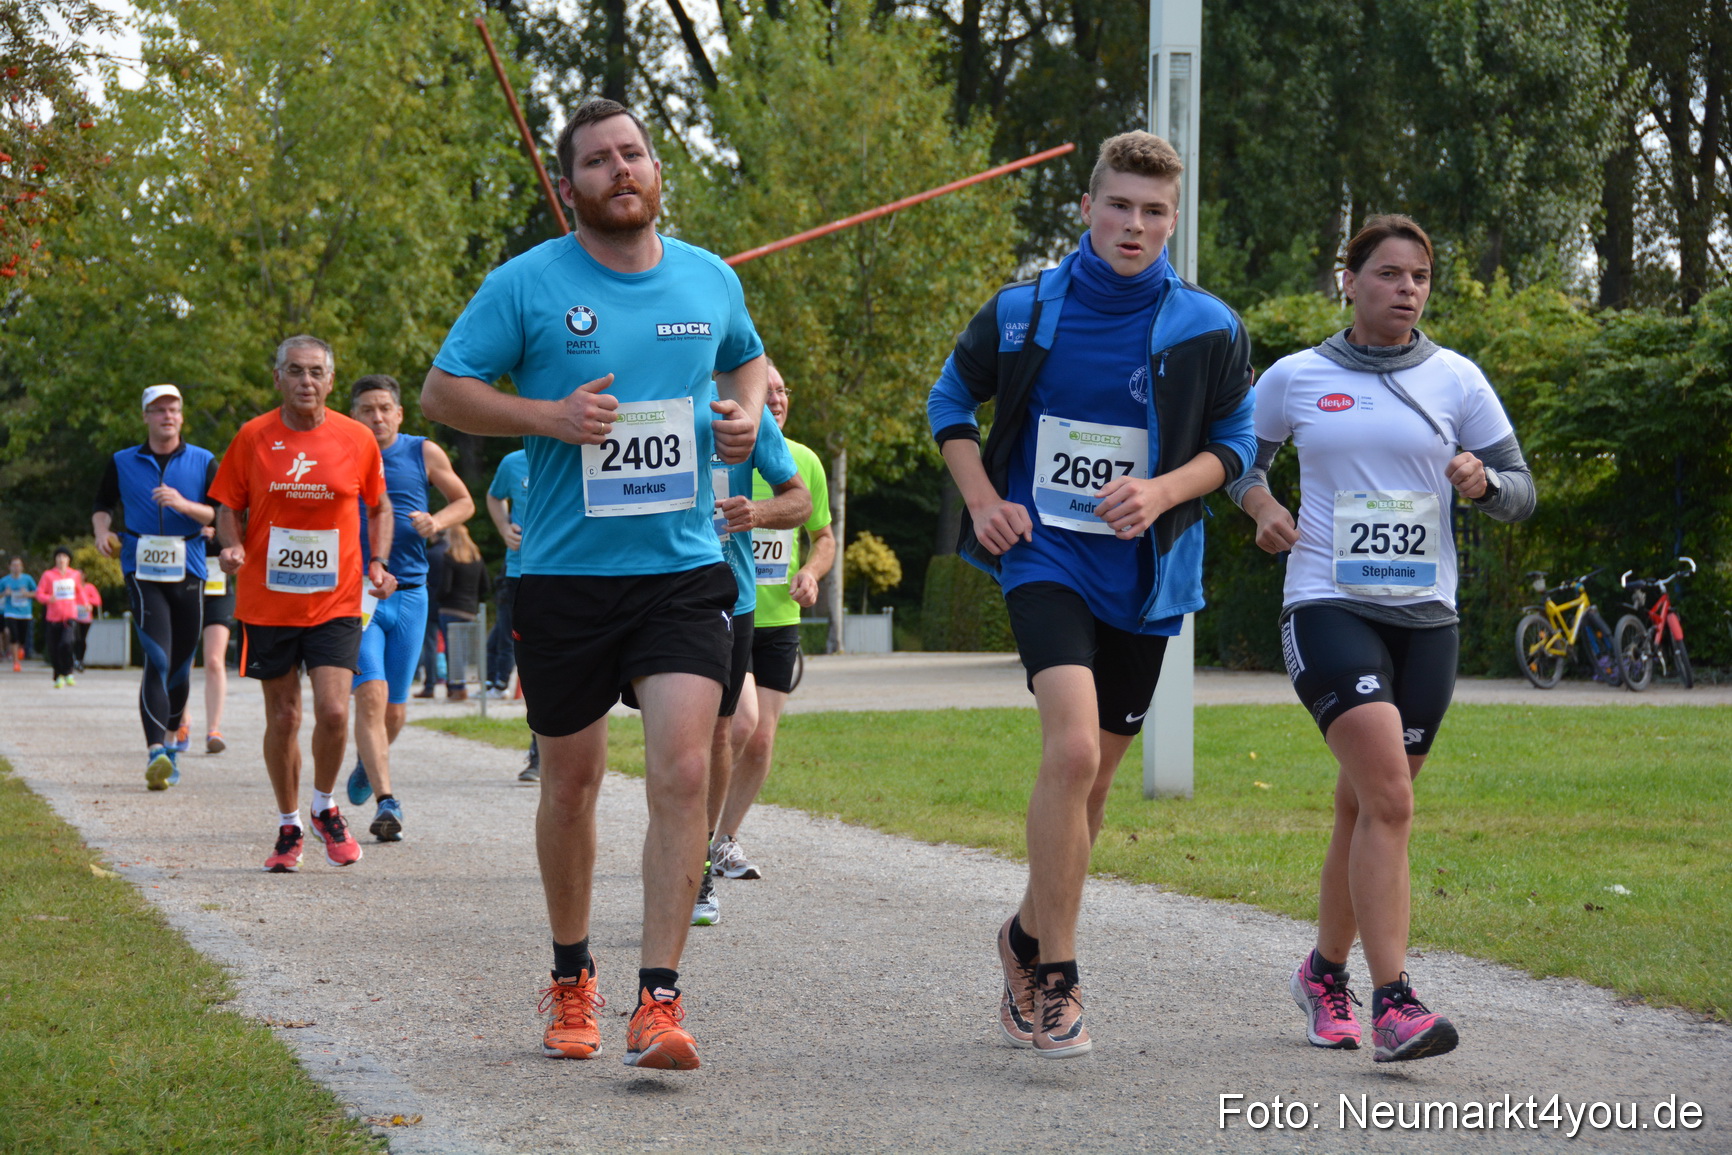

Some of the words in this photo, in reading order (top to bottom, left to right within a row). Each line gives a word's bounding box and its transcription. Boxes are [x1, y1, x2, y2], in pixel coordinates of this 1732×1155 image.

[569, 306, 595, 317] BMW
[656, 323, 711, 336] BOCK
[1005, 322, 1030, 330] GANS
[567, 341, 600, 349] PARTL
[1320, 397, 1352, 408] Hervis
[627, 411, 666, 423] BOCK
[1080, 432, 1122, 445] BOCK
[600, 434, 681, 472] 2403
[1051, 452, 1135, 490] 2697
[269, 481, 327, 493] funrunners
[623, 482, 666, 496] Markus
[286, 490, 335, 500] neumarkt
[1069, 499, 1096, 513] Andr
[1378, 500, 1414, 510] BOCK
[1350, 522, 1426, 556] 2532
[143, 549, 177, 564] 2021
[752, 540, 783, 560] 270
[278, 548, 328, 569] 2949
[755, 564, 774, 575] fgang
[1362, 565, 1416, 579] Stephanie
[276, 572, 331, 586] ERNST
[1281, 621, 1301, 682] CARRERA
